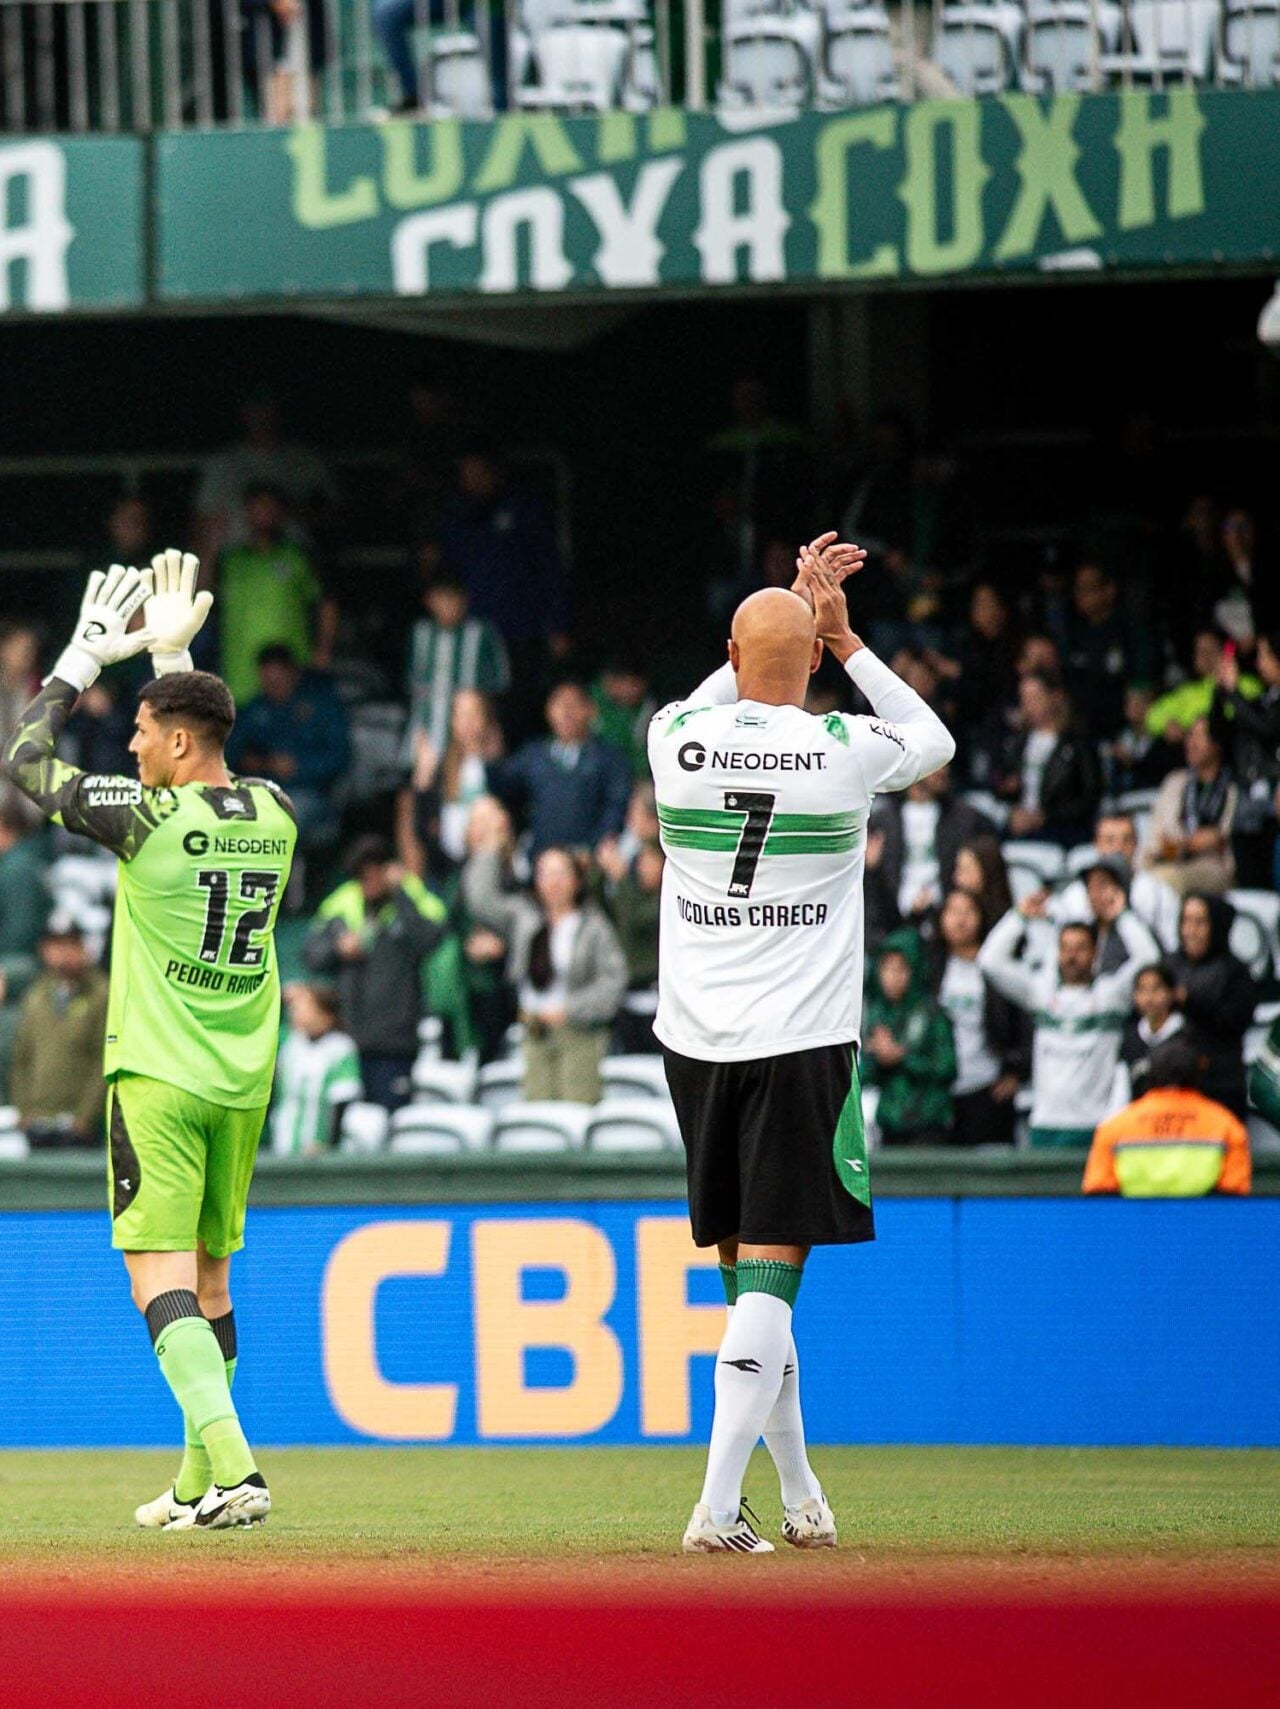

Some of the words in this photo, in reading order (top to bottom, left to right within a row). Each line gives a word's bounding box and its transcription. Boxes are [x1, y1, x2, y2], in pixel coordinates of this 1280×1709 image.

[214, 837, 288, 855] NEODENT
[724, 791, 776, 899] 7
[198, 870, 279, 965] 12
[677, 895, 741, 926] NICOLAS
[748, 904, 827, 926] CARECA
[165, 959, 225, 990] PEDRO
[322, 1216, 728, 1440] CBF
